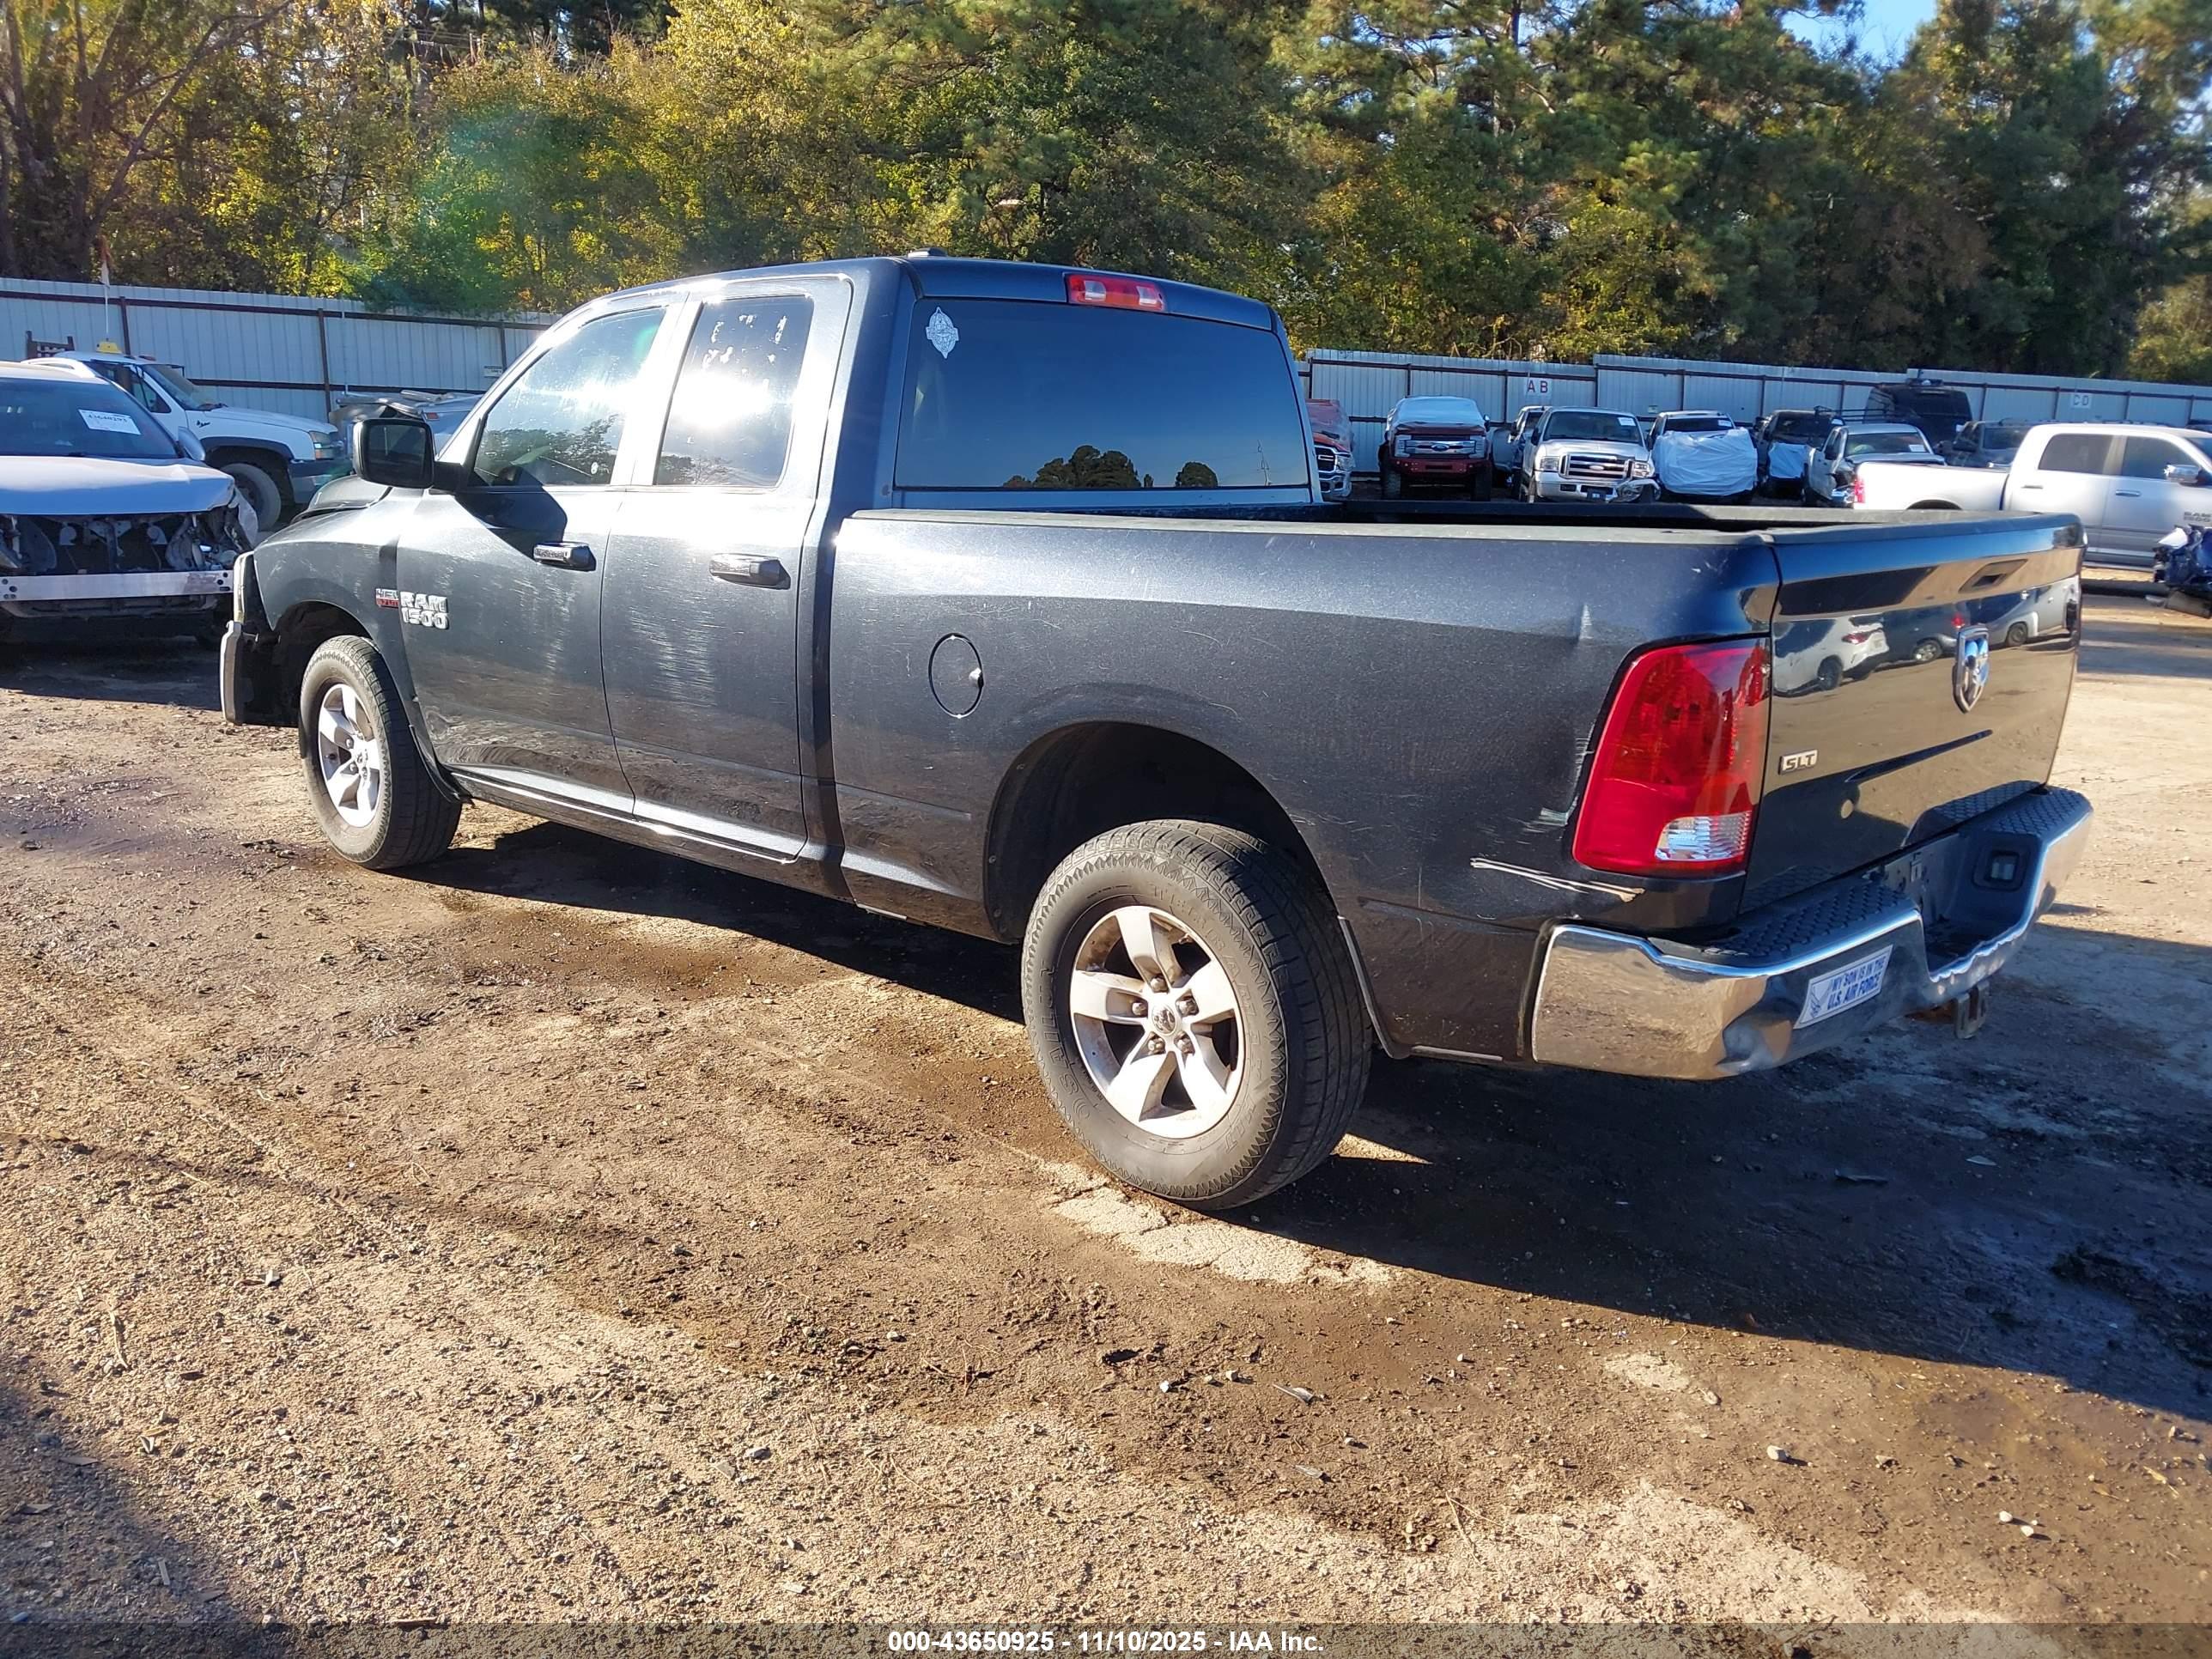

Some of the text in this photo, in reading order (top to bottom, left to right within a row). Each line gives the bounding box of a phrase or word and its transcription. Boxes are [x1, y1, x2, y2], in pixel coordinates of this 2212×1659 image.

[1528, 380, 1548, 393] A B
[400, 592, 447, 612] RAM
[401, 607, 449, 630] 1500
[1786, 754, 1816, 770] SLT
